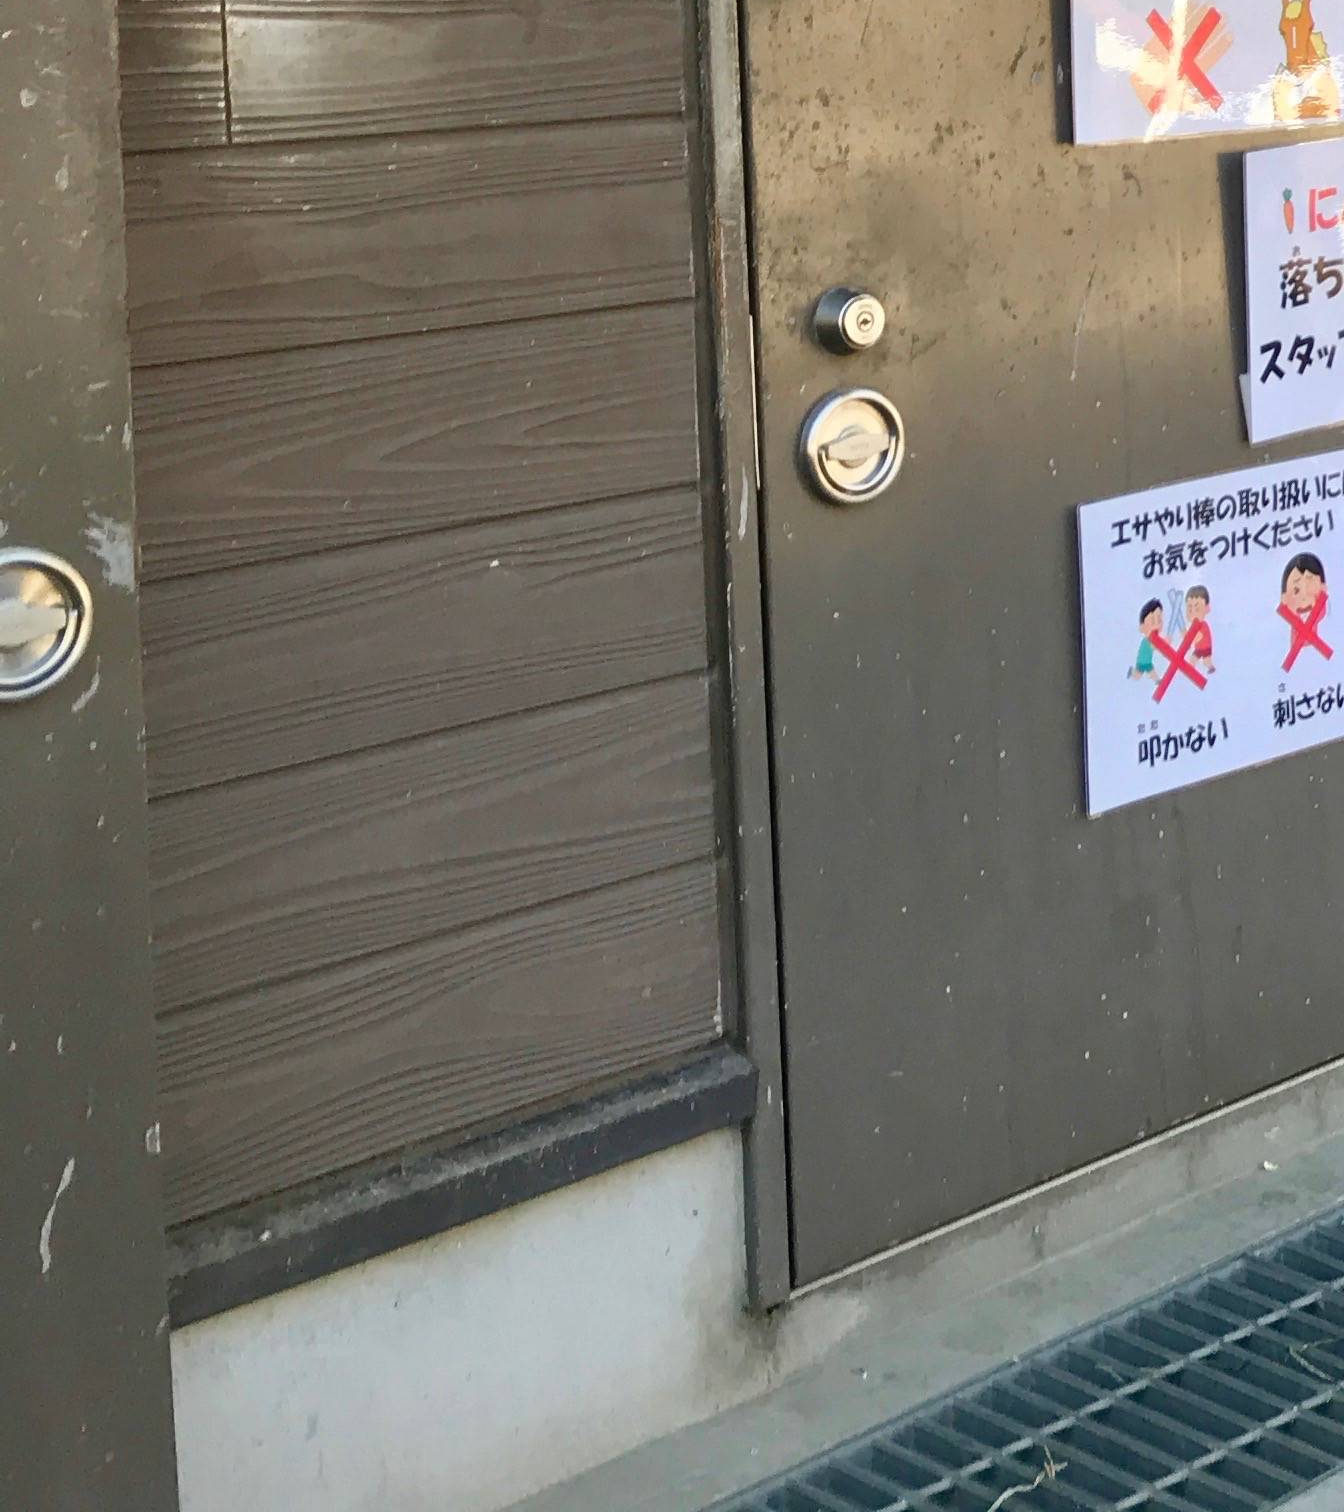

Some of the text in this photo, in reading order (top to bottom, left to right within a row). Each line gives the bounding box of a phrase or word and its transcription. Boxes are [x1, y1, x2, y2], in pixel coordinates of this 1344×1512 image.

[1142, 509, 1335, 579] お気をつけください
[1137, 717, 1229, 767] 叩かない
